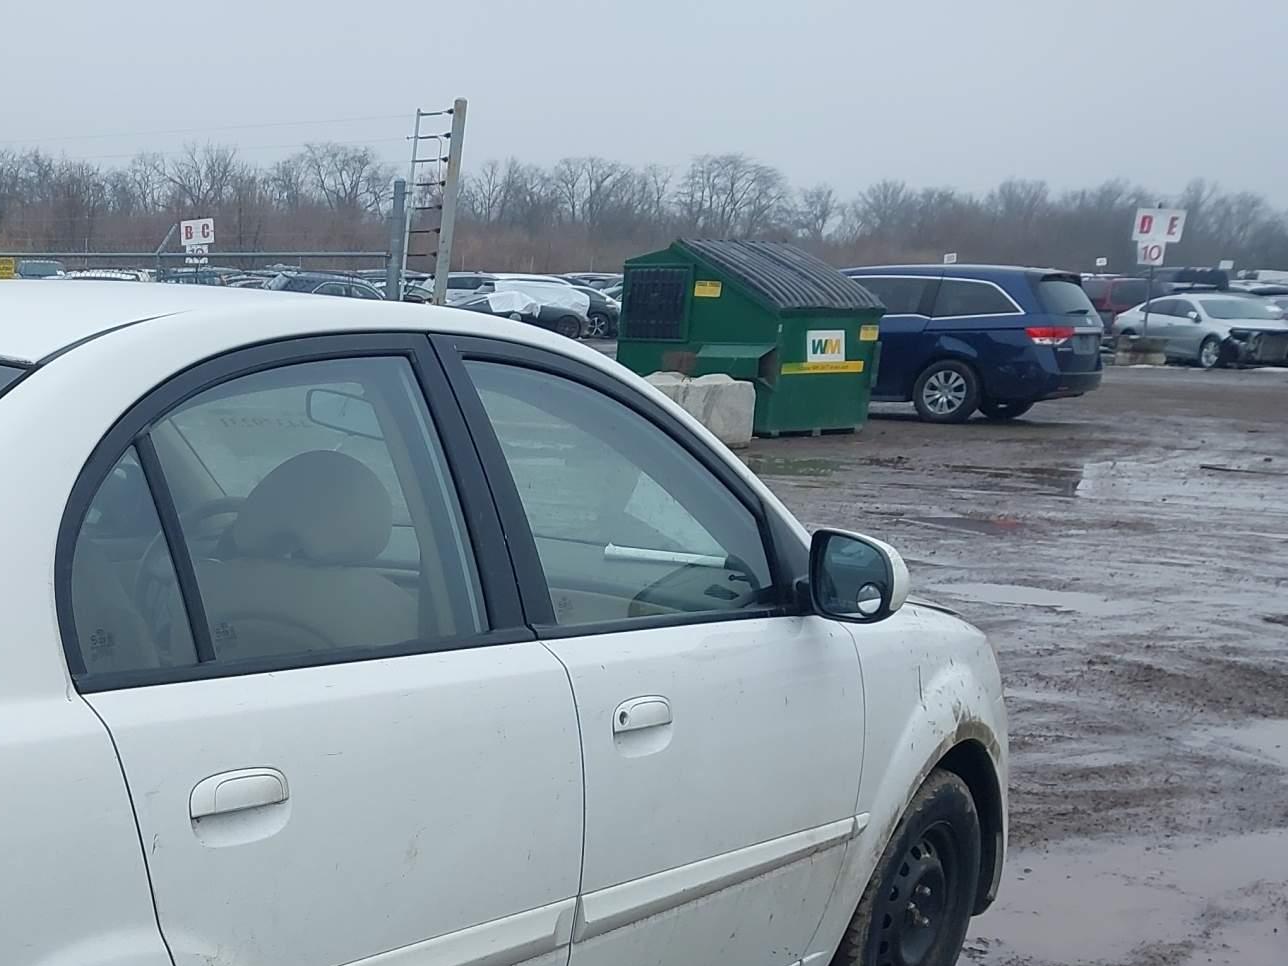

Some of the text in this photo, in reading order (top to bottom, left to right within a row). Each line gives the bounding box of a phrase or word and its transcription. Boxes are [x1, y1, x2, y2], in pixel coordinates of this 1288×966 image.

[184, 223, 210, 240] B C
[1139, 215, 1179, 235] D E
[1142, 245, 1161, 261] 10
[812, 339, 840, 354] WM
